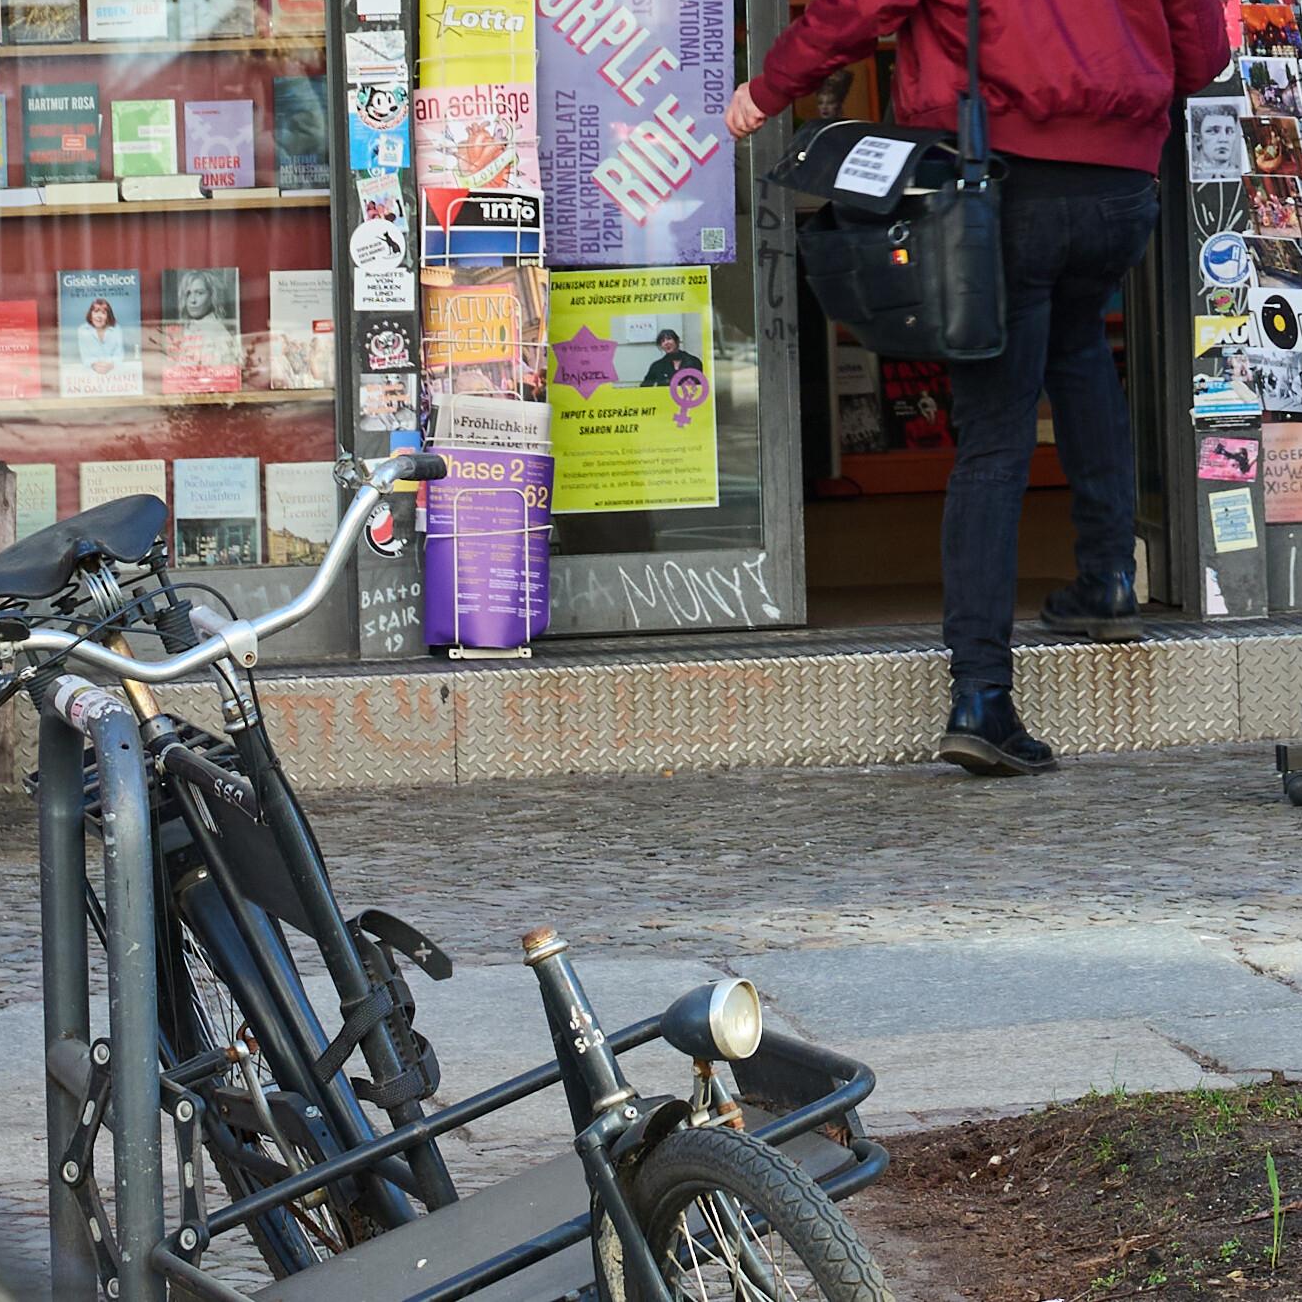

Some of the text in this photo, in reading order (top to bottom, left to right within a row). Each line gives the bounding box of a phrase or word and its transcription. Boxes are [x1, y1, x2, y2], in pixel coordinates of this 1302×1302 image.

[444, 4, 526, 33] Lotta
[703, 0, 724, 53] MARCH
[28, 95, 96, 112] HARTMUT ROSA
[703, 68, 724, 116] 2026
[193, 155, 241, 170] GENDER
[556, 89, 577, 255] MARIANNENPLATZ
[591, 93, 720, 227] RIDE
[201, 172, 235, 187] UNKS
[579, 103, 600, 254] BLN-KREUZBERG
[480, 197, 536, 221] info
[603, 201, 624, 252] 12PM
[64, 273, 136, 287] Gisèle Pelicot
[551, 275, 708, 291] EMINISMUS NACH DEM 7. OKTOBER 2023
[429, 296, 513, 324] HALTUNG
[570, 292, 685, 306] AUS JÜDISCHER PERSPEKTIVE
[1200, 322, 1249, 347] FAU
[560, 406, 657, 420] INPUT & GESPRÄCH MIT
[453, 415, 538, 436] »Fröhlichkeit
[579, 423, 639, 435] SHARON ADLER
[87, 463, 163, 475] SUSANNE HEIM
[510, 458, 524, 483] 2
[523, 484, 549, 509] 62
